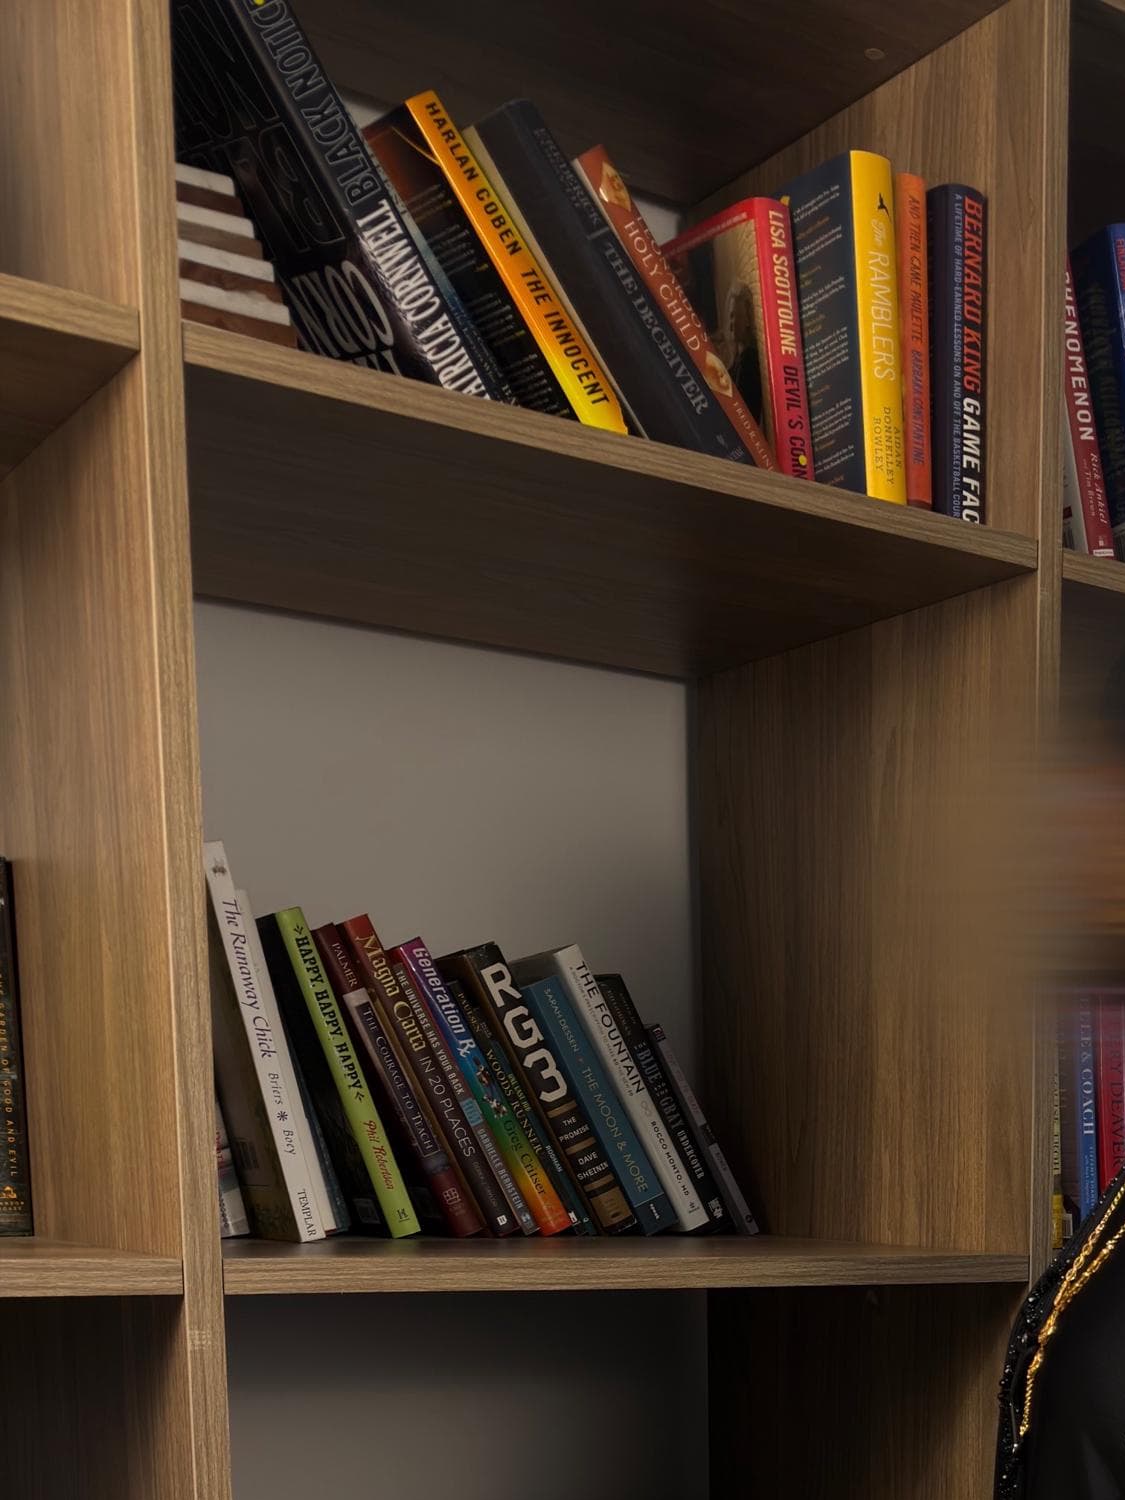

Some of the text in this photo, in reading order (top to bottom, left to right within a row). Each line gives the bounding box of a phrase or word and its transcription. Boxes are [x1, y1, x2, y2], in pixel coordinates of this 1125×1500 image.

[300, 93, 383, 207] BLACK
[768, 210, 786, 249] LISA
[909, 195, 921, 221] AND
[909, 222, 922, 254] THEN
[356, 198, 441, 322] CORNWELL
[426, 102, 479, 181] HARLAN
[476, 187, 523, 256] COBEN
[520, 266, 552, 306] THE
[545, 310, 610, 407] INNOCENT
[623, 220, 701, 352] HOLY CHILD
[910, 255, 922, 290] CAME
[603, 241, 710, 416] THE DECEIVER
[772, 253, 798, 358] SCOTTOLINE
[868, 250, 896, 381] RAMBLERS
[911, 289, 923, 345] PAULETTE
[953, 322, 963, 363] LESSONS
[962, 196, 984, 474] BERNARD KING GAME
[332, 942, 358, 989] PALMER
[411, 947, 466, 1034] Generation
[355, 934, 475, 1157] Magna Carta IN 20 PLACES
[402, 984, 465, 1096] UNIVERSE YOUR BACK
[481, 962, 568, 1103] RG3
[544, 988, 579, 1053] SARAH DESSEN
[595, 1002, 646, 1094] FOUNTAIN
[222, 898, 317, 1236] The Runaway Chick Briers Boey TEMPLAR
[333, 1038, 362, 1091] HAPPY
[375, 1034, 432, 1151] COURAGE TO TEACH
[486, 1048, 543, 1155] WOODS RUNNER
[1082, 1067, 1096, 1136] COACH
[363, 1120, 379, 1143] Phil
[559, 1125, 590, 1143] PROMISE
[563, 1116, 577, 1127] THE
[578, 1151, 599, 1166] DAVE
[593, 1092, 622, 1139] MOON
[623, 1152, 649, 1192] MORE
[650, 1121, 668, 1150] ROCCO
[658, 1096, 681, 1130] GRAY
[677, 1130, 705, 1179] UNDERCOVER
[1111, 1082, 1125, 1167] DEAVER
[476, 1129, 525, 1210] GABRIELLE BERNSTEIN
[521, 1153, 546, 1195] Critser
